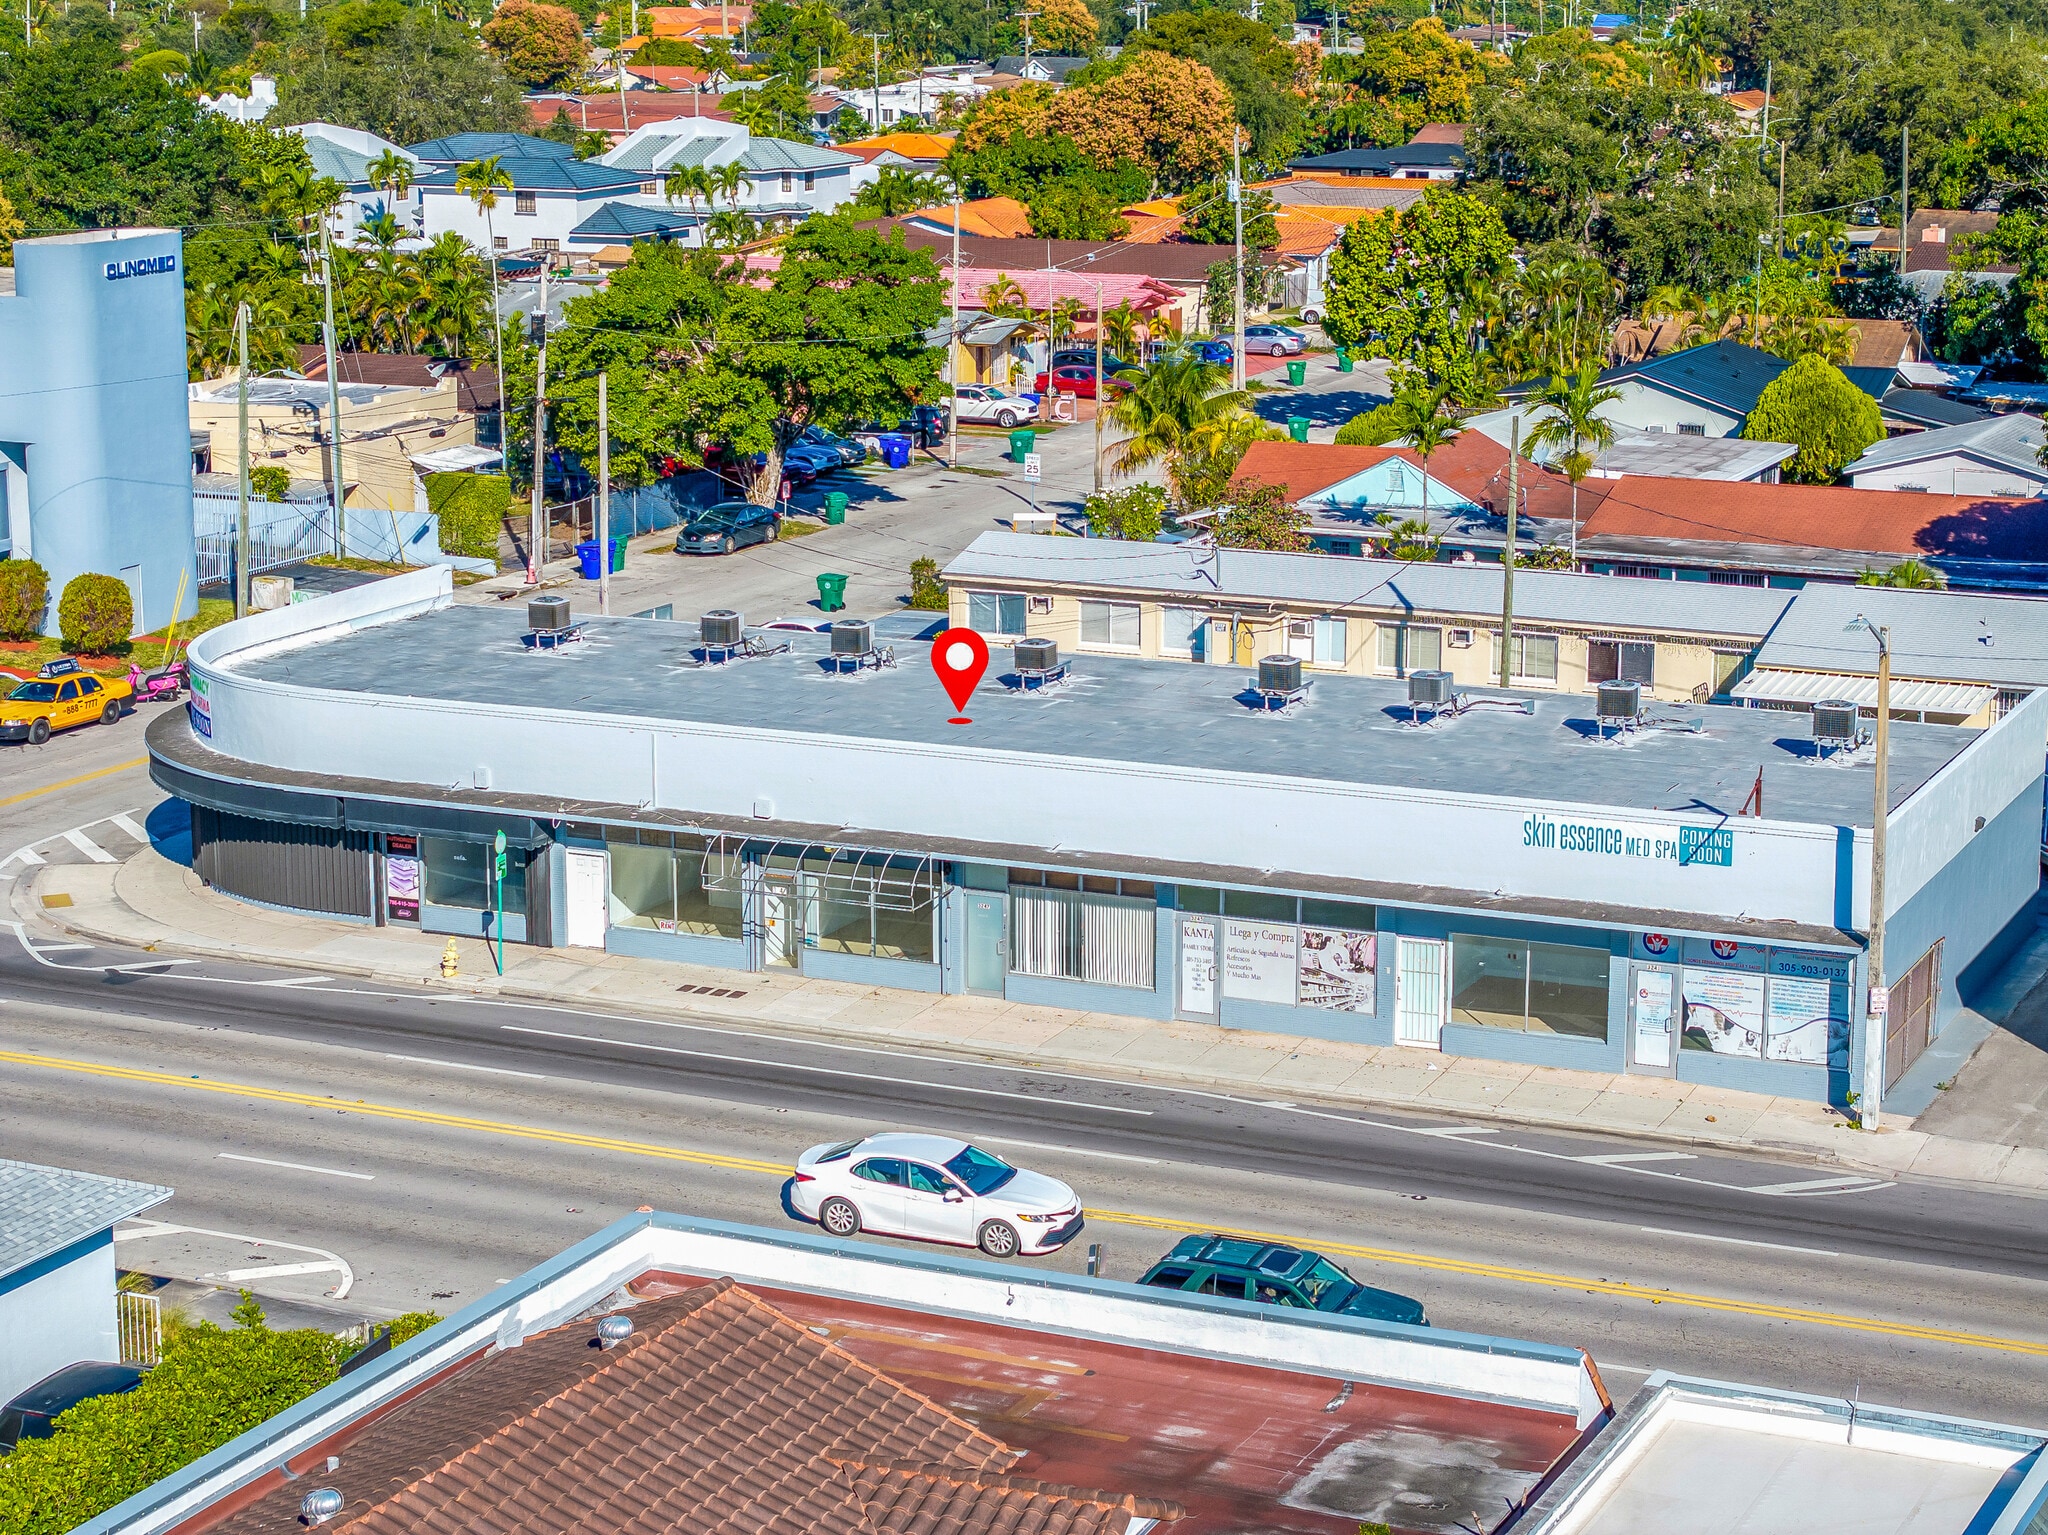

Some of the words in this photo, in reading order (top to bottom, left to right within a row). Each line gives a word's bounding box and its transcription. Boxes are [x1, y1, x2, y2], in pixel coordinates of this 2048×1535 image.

[1026, 465, 1039, 474] 25
[1523, 814, 1555, 848] skin
[1560, 823, 1622, 855] essence
[1625, 837, 1650, 857] MED
[1655, 839, 1677, 860] SPA
[1681, 829, 1732, 849] COMING
[391, 842, 412, 850] DEALER
[1688, 846, 1723, 863] SOON
[1184, 926, 1215, 940] KANTA
[1254, 931, 1260, 942] y
[1261, 929, 1295, 945] Compra
[1183, 943, 1199, 951] FAMILY
[1226, 953, 1251, 962] Refrescos
[1251, 948, 1258, 956] de
[1258, 949, 1279, 959] Segunda
[1280, 951, 1295, 960] Mano
[1226, 962, 1253, 971] Accesorios
[1778, 962, 1847, 977] 305-903-0137
[1232, 971, 1250, 979] Mucho
